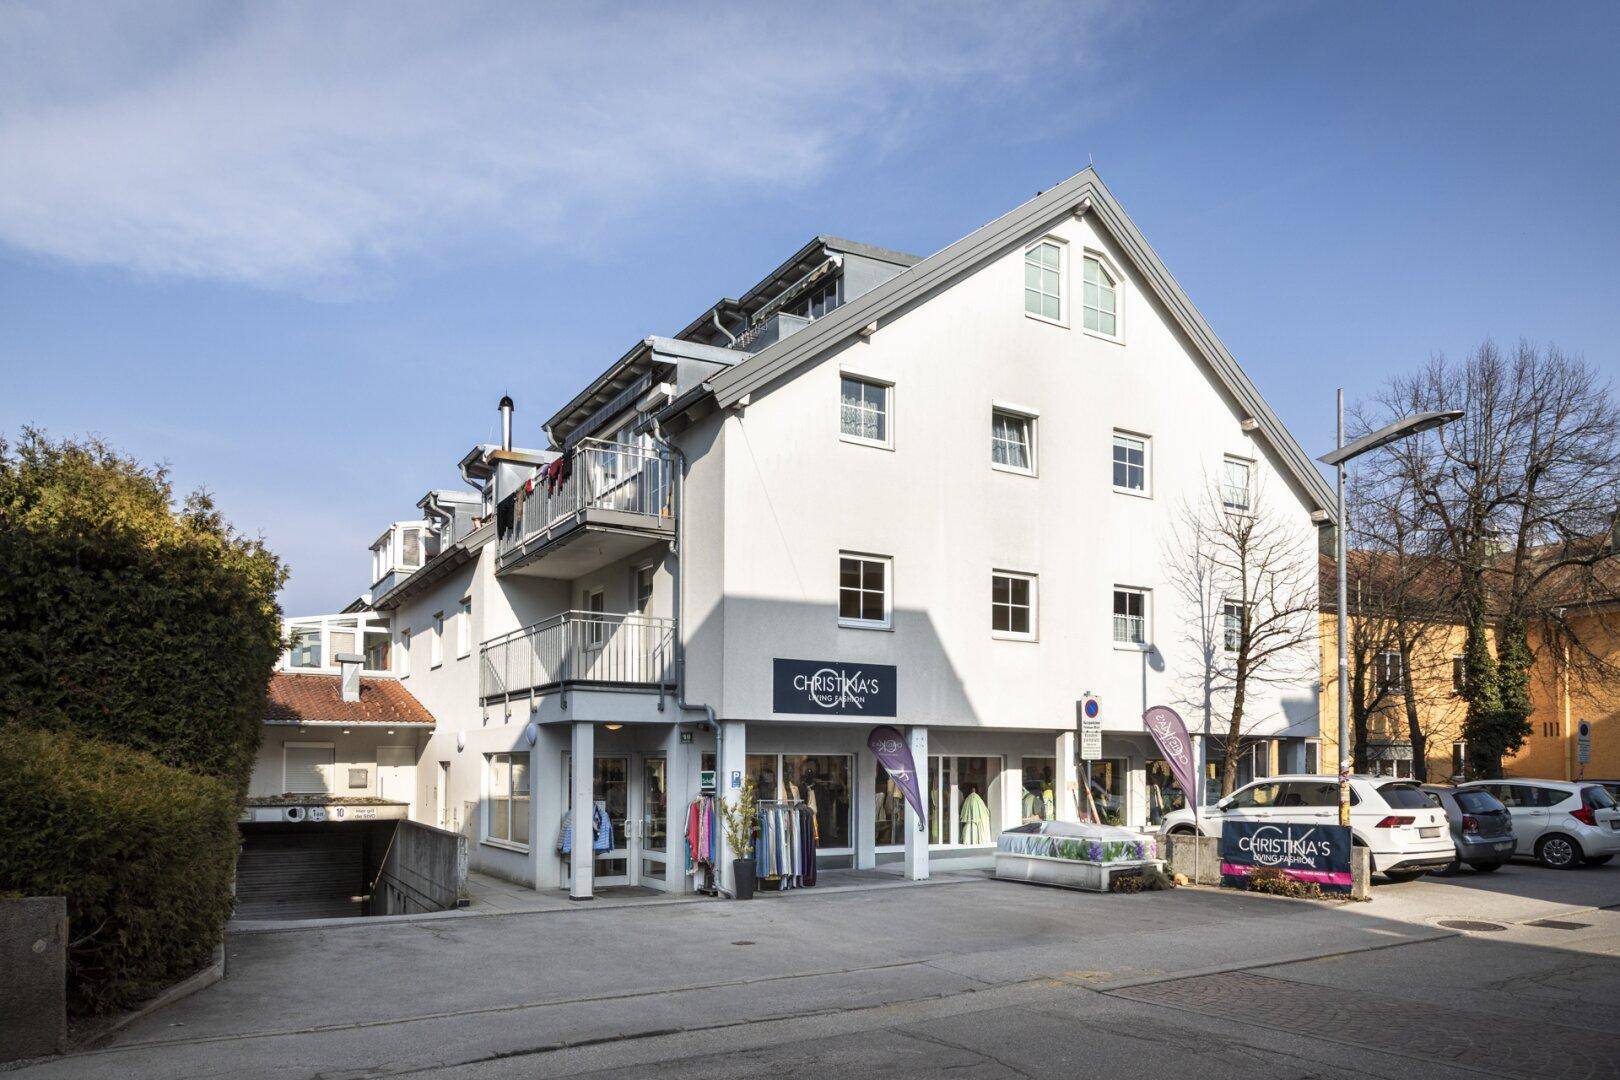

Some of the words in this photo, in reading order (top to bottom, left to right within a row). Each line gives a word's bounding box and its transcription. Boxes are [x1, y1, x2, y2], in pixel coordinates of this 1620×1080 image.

[793, 674, 880, 695] CHRISTINA'S
[808, 694, 833, 703] LIVING
[834, 695, 866, 704] FASHION
[733, 772, 740, 780] P
[336, 808, 345, 818] 10
[1238, 836, 1331, 857] CHRISTINA'S
[1253, 853, 1278, 864] LIVING
[1279, 854, 1315, 865] FASHION
